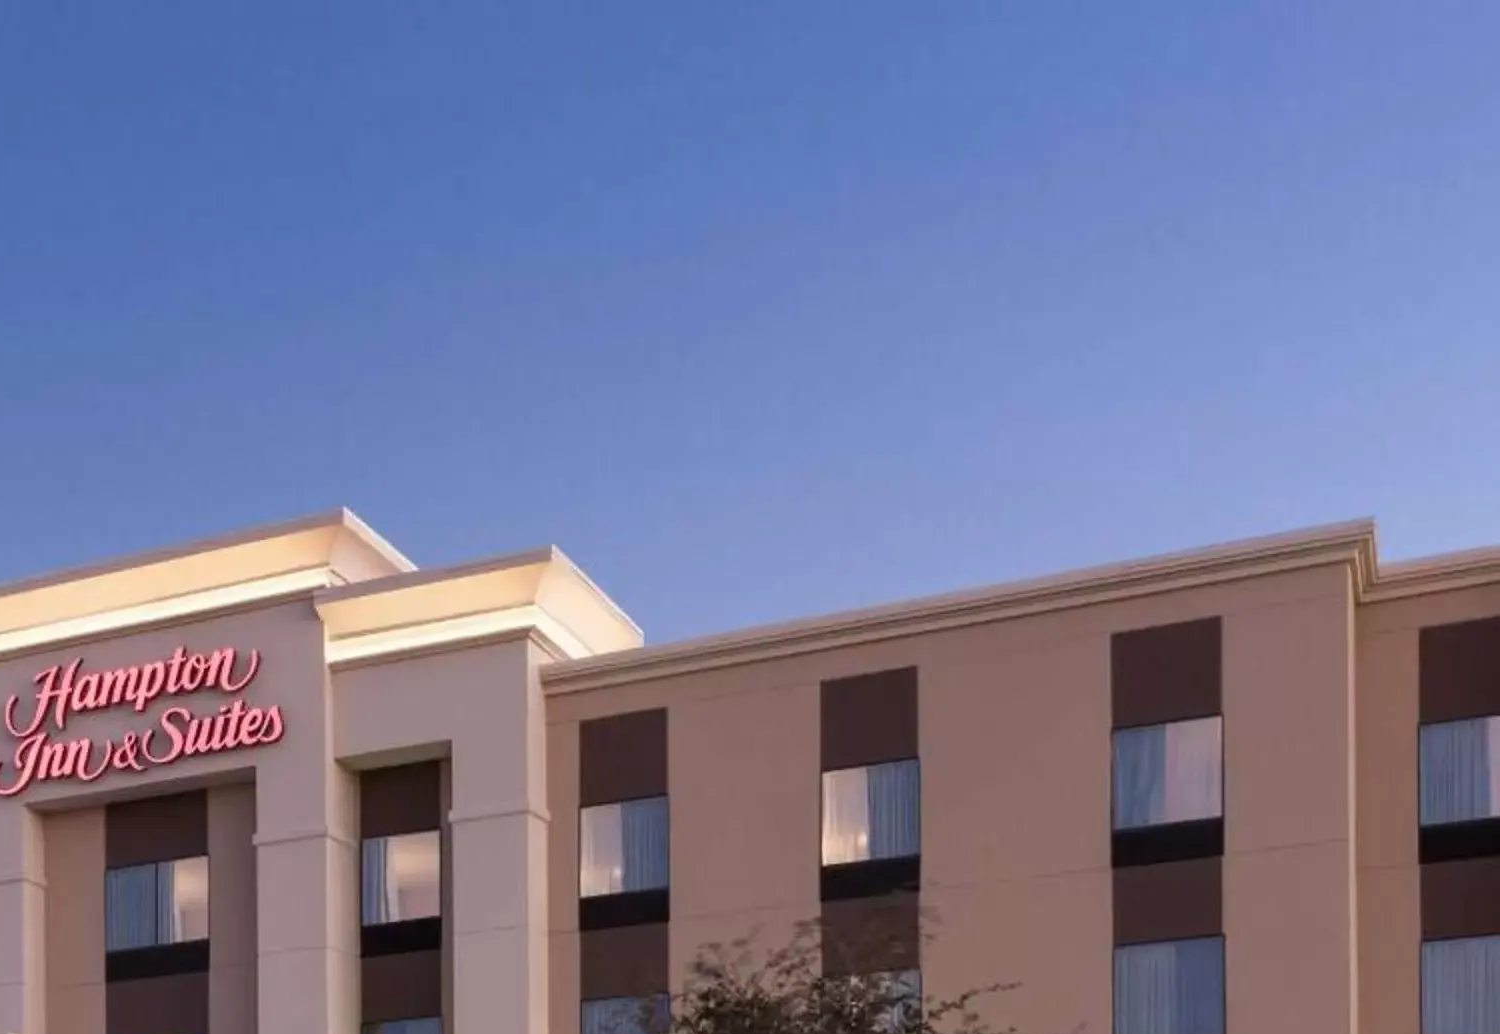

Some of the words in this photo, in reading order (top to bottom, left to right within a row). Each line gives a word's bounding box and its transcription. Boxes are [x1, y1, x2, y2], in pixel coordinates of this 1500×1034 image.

[5, 645, 260, 738] Hampton
[112, 730, 146, 771] &
[140, 700, 284, 764] Suites
